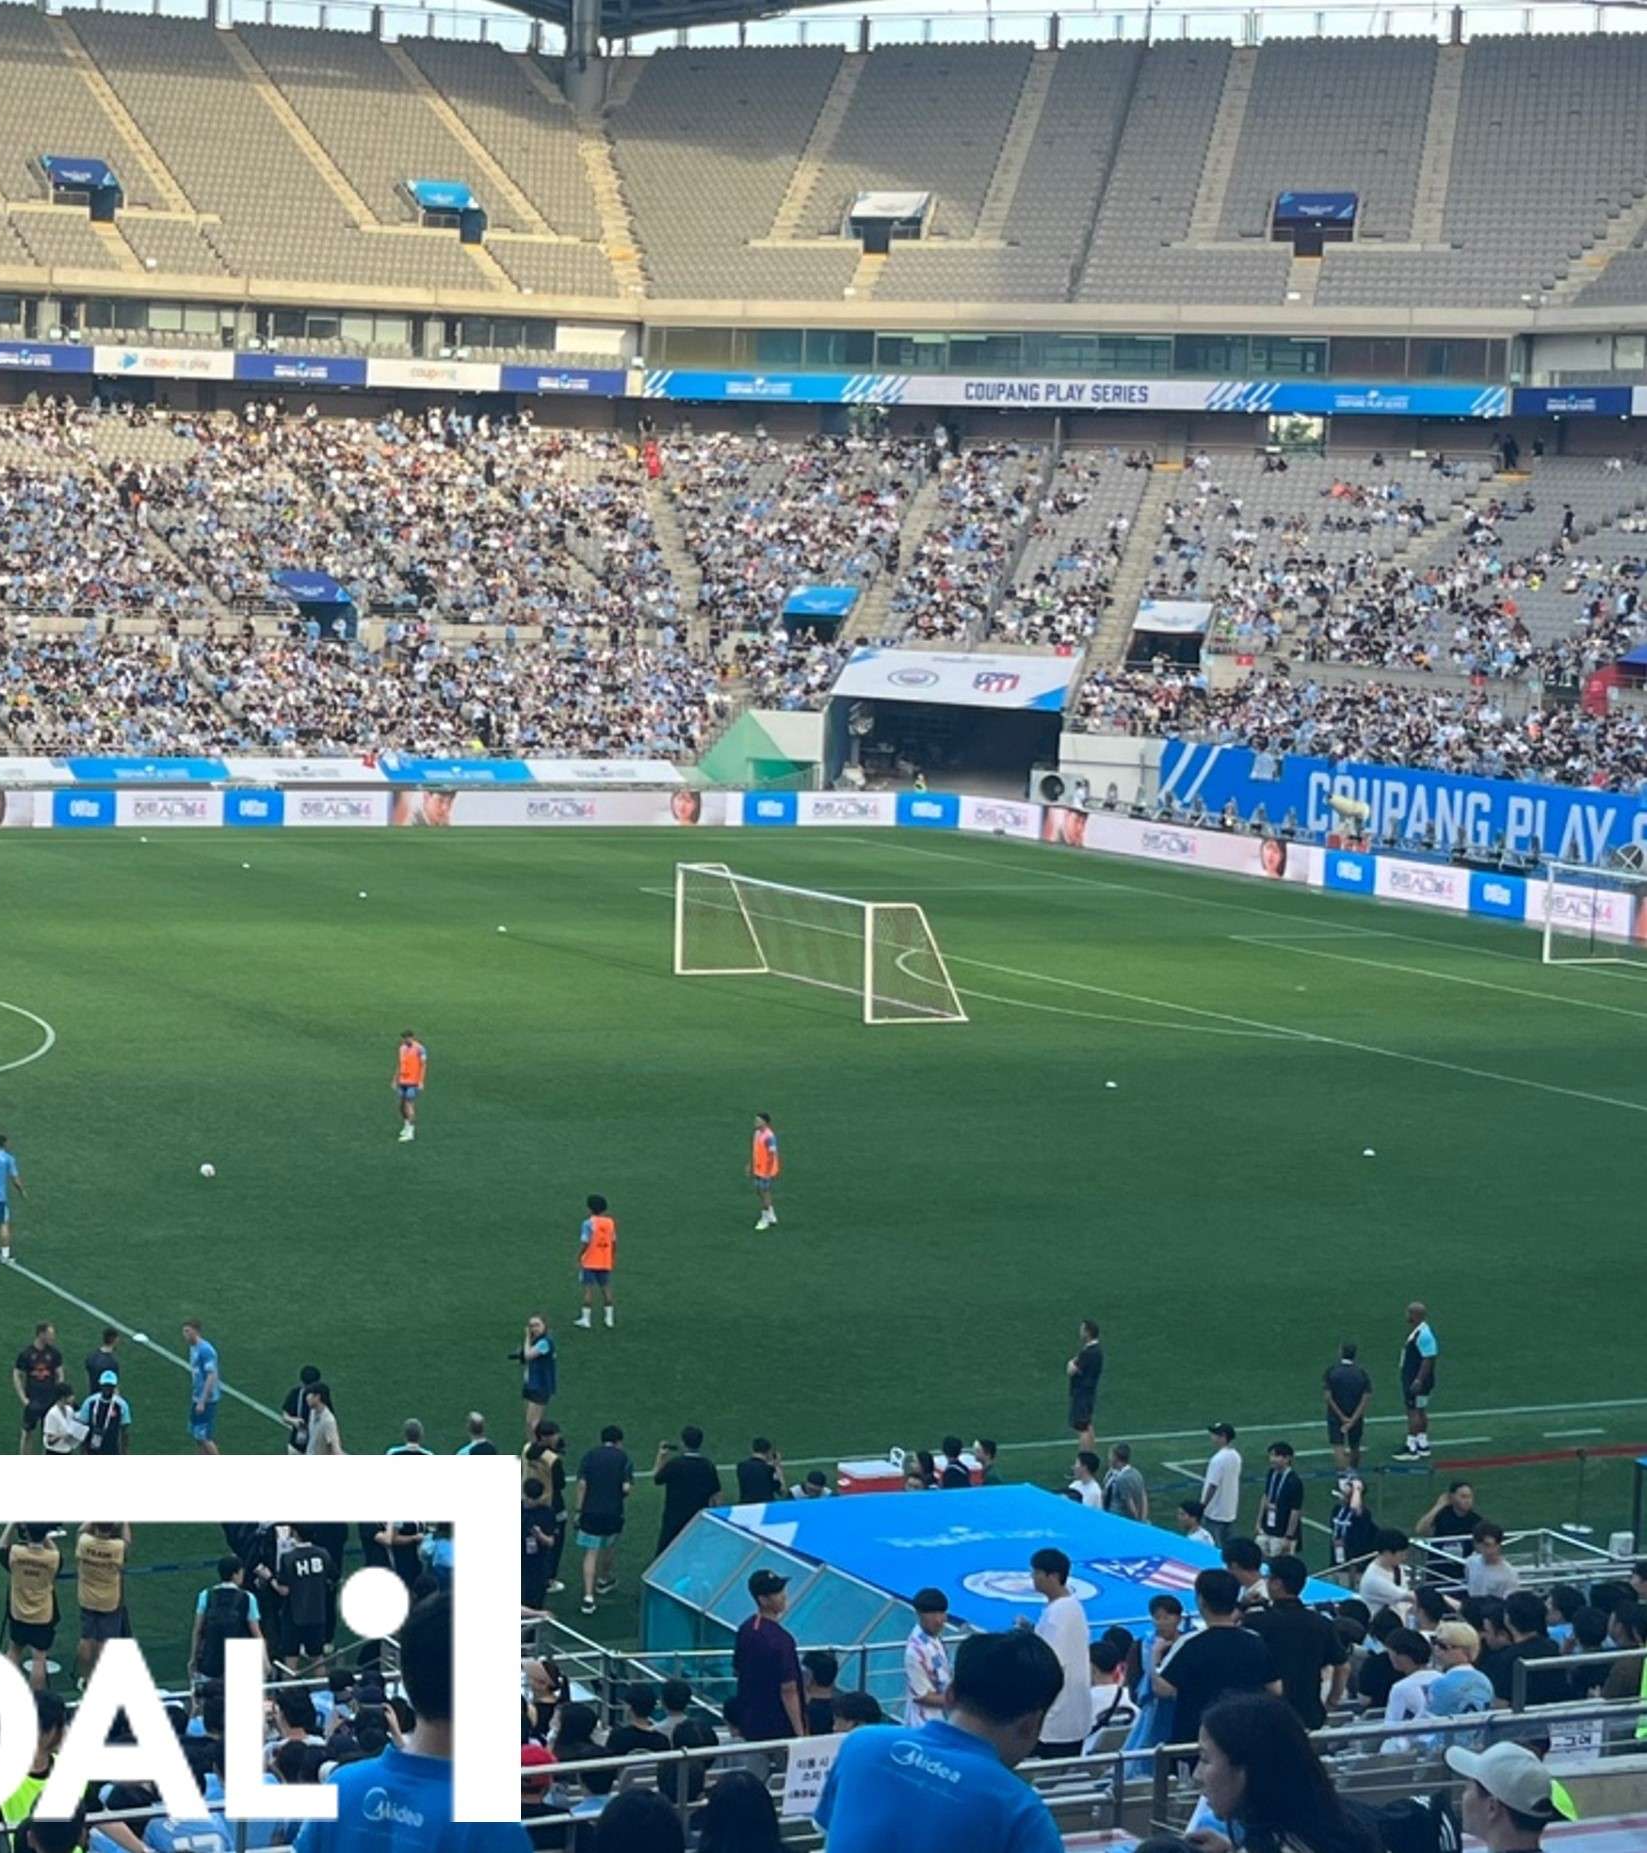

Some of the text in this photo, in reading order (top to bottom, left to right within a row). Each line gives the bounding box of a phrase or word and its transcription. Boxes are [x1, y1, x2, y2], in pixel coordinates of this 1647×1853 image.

[965, 383, 1149, 403] COUPANG PLAY SERIES
[892, 1743, 960, 1783] Midea
